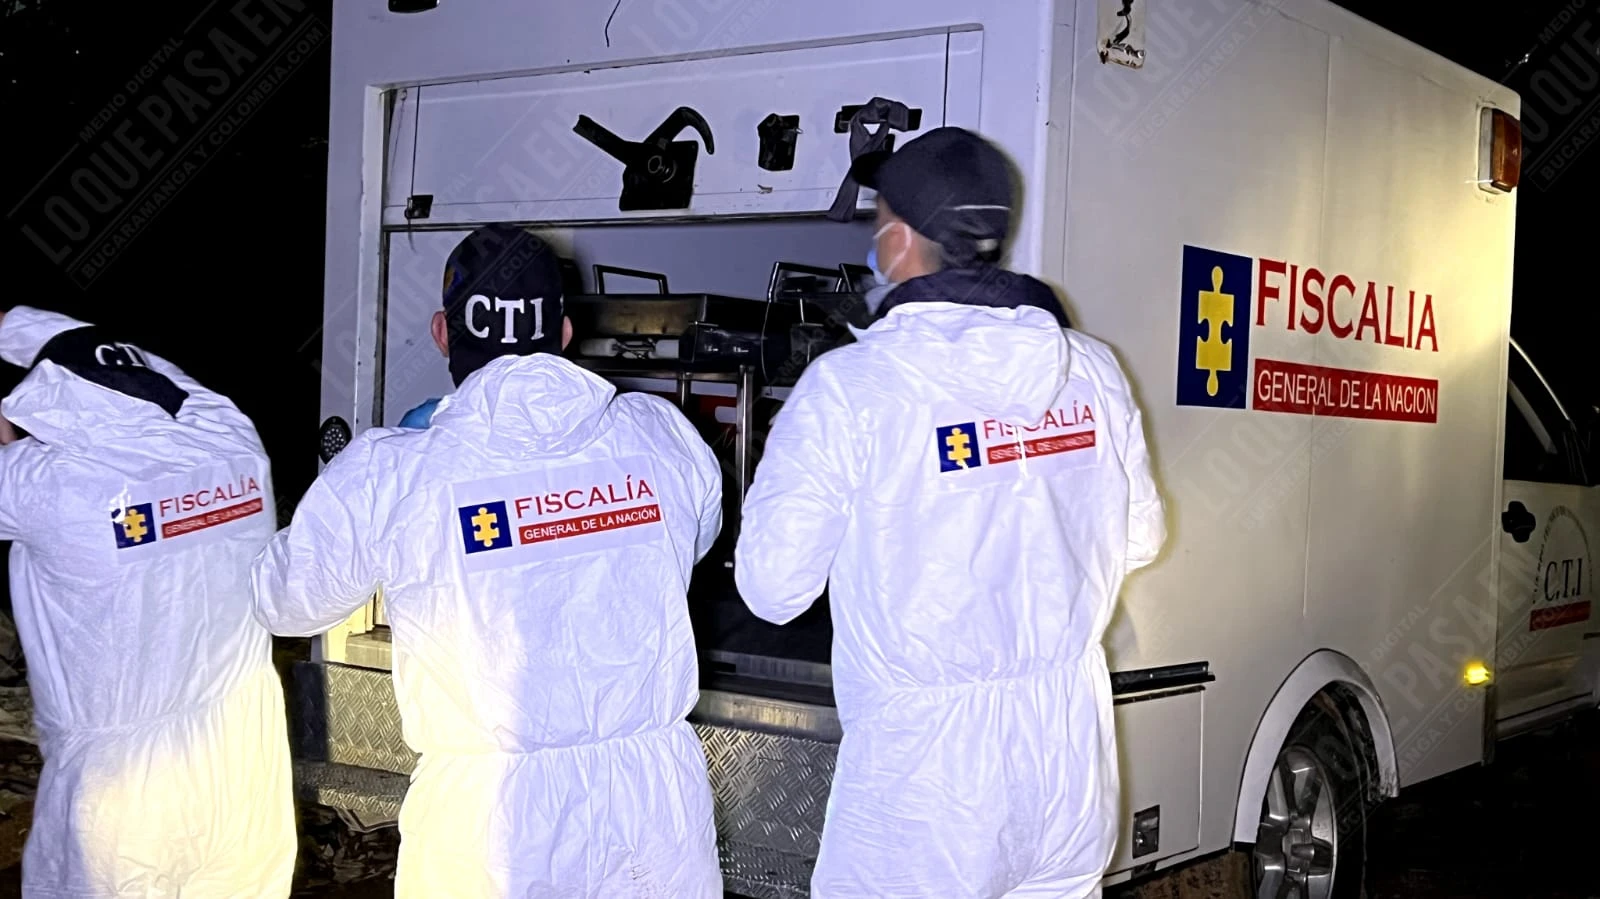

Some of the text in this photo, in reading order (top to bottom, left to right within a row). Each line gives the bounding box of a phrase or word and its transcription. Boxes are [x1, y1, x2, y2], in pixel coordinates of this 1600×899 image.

[464, 294, 545, 344] CTI
[1256, 258, 1439, 352] FISCALIA
[1257, 369, 1436, 414] GENERAL DE LA NACION
[158, 474, 261, 518] FISCALÍA
[514, 474, 655, 520] FISCALÍA
[524, 507, 658, 541] GENERAL DE LA NACIÓN
